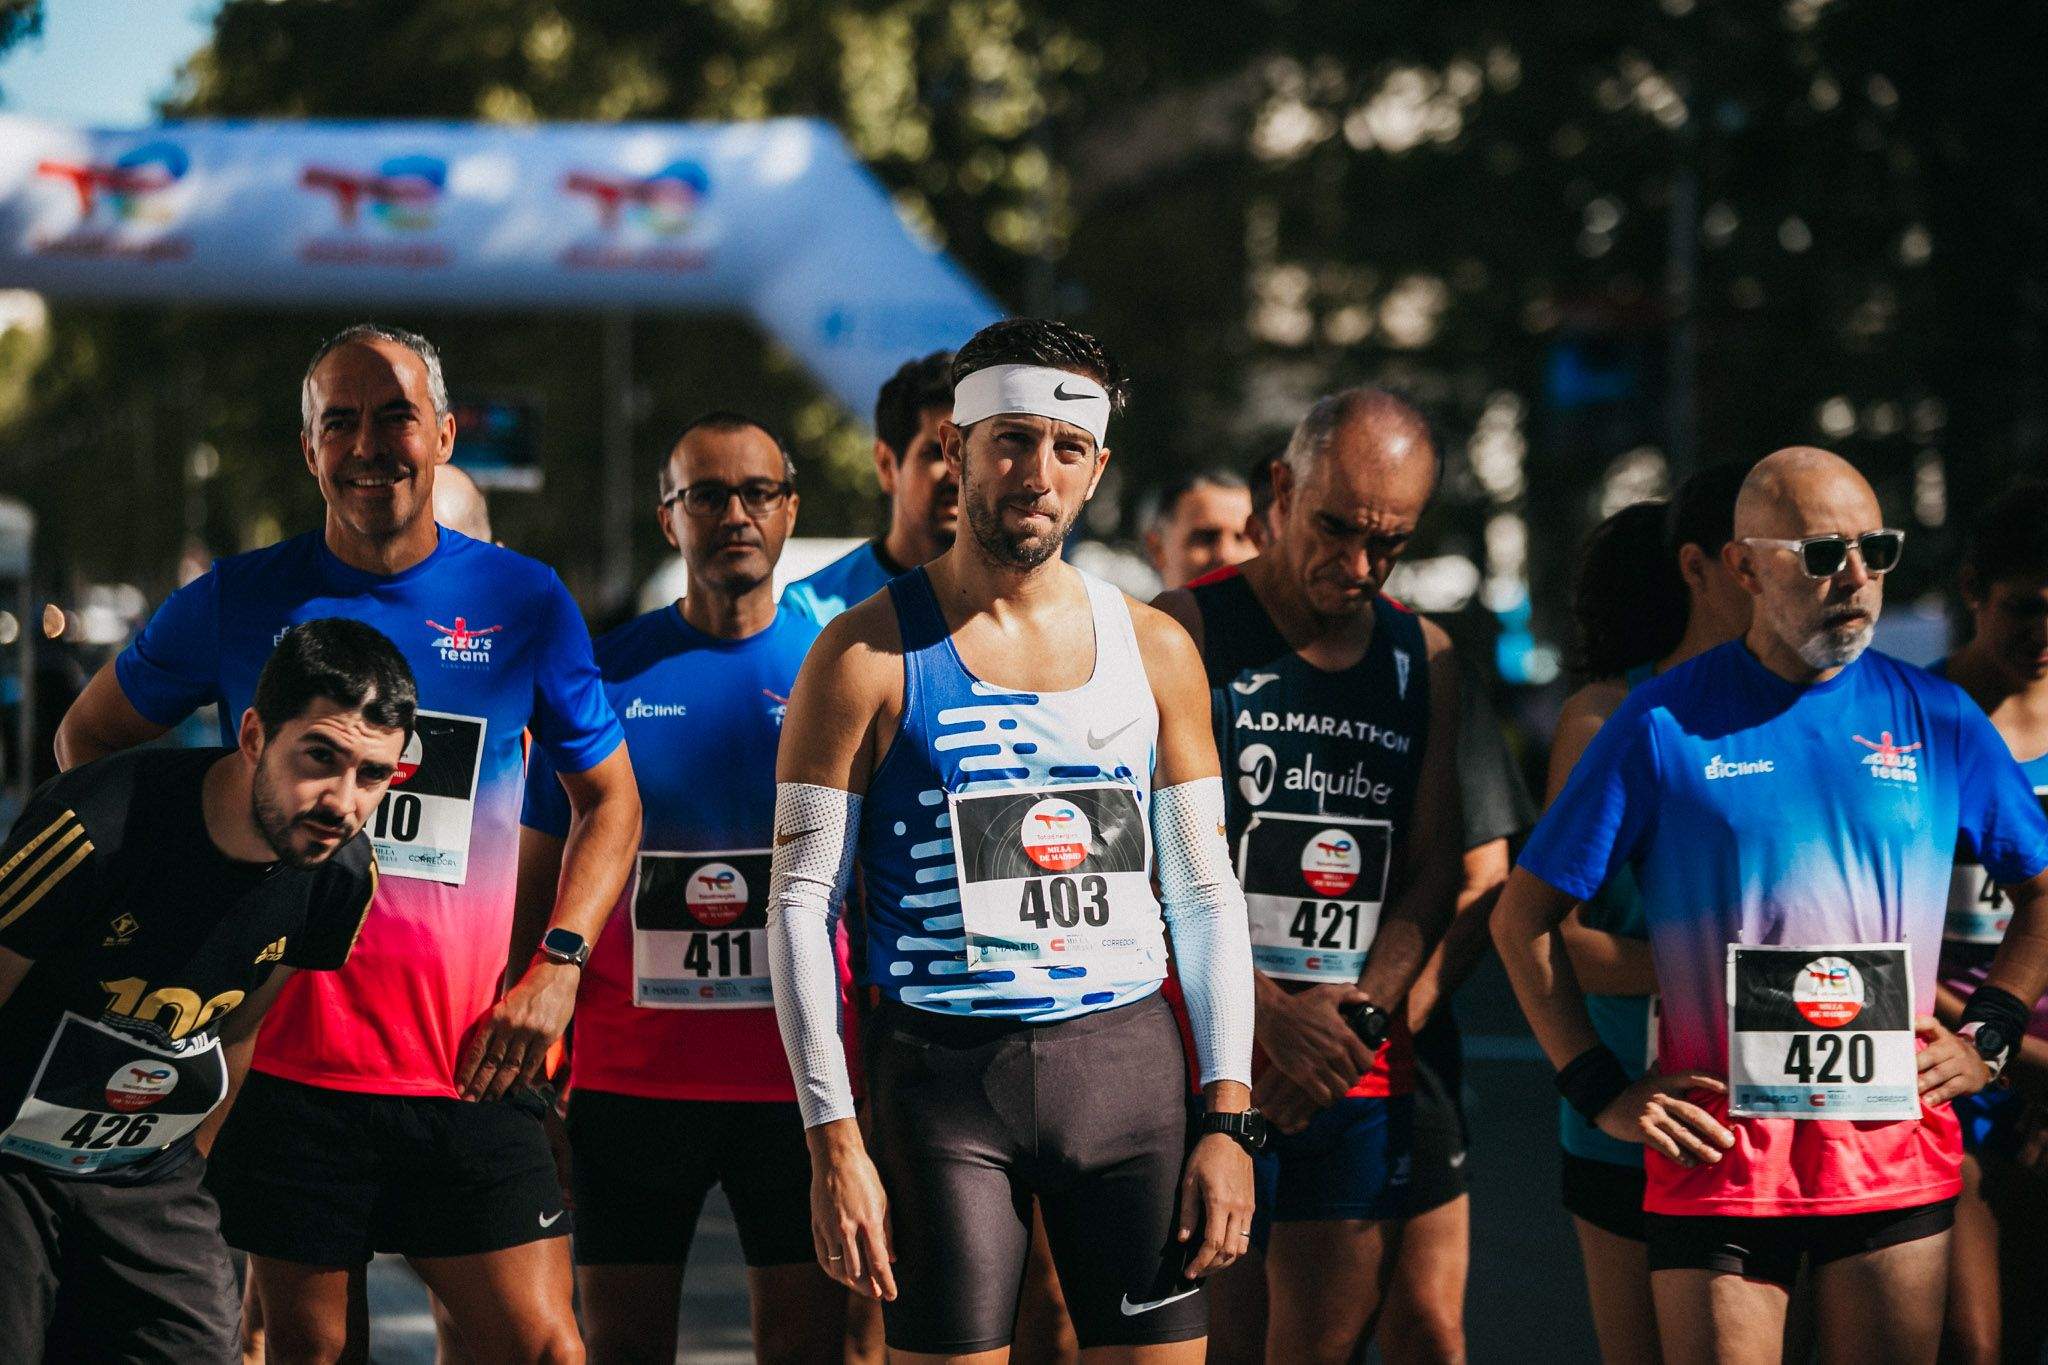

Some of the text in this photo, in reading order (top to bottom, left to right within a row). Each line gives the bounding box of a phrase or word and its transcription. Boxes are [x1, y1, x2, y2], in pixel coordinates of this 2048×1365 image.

[440, 647, 490, 663] team
[1870, 765, 1917, 783] team
[1039, 852, 1081, 862] DE MADRID
[1047, 845, 1072, 853] MILLA
[1019, 875, 1110, 929] 403
[1289, 901, 1360, 950] 421
[683, 931, 751, 978] 411
[995, 942, 1039, 952] MADRID
[1784, 1033, 1874, 1084] 420
[61, 1112, 160, 1149] 426
